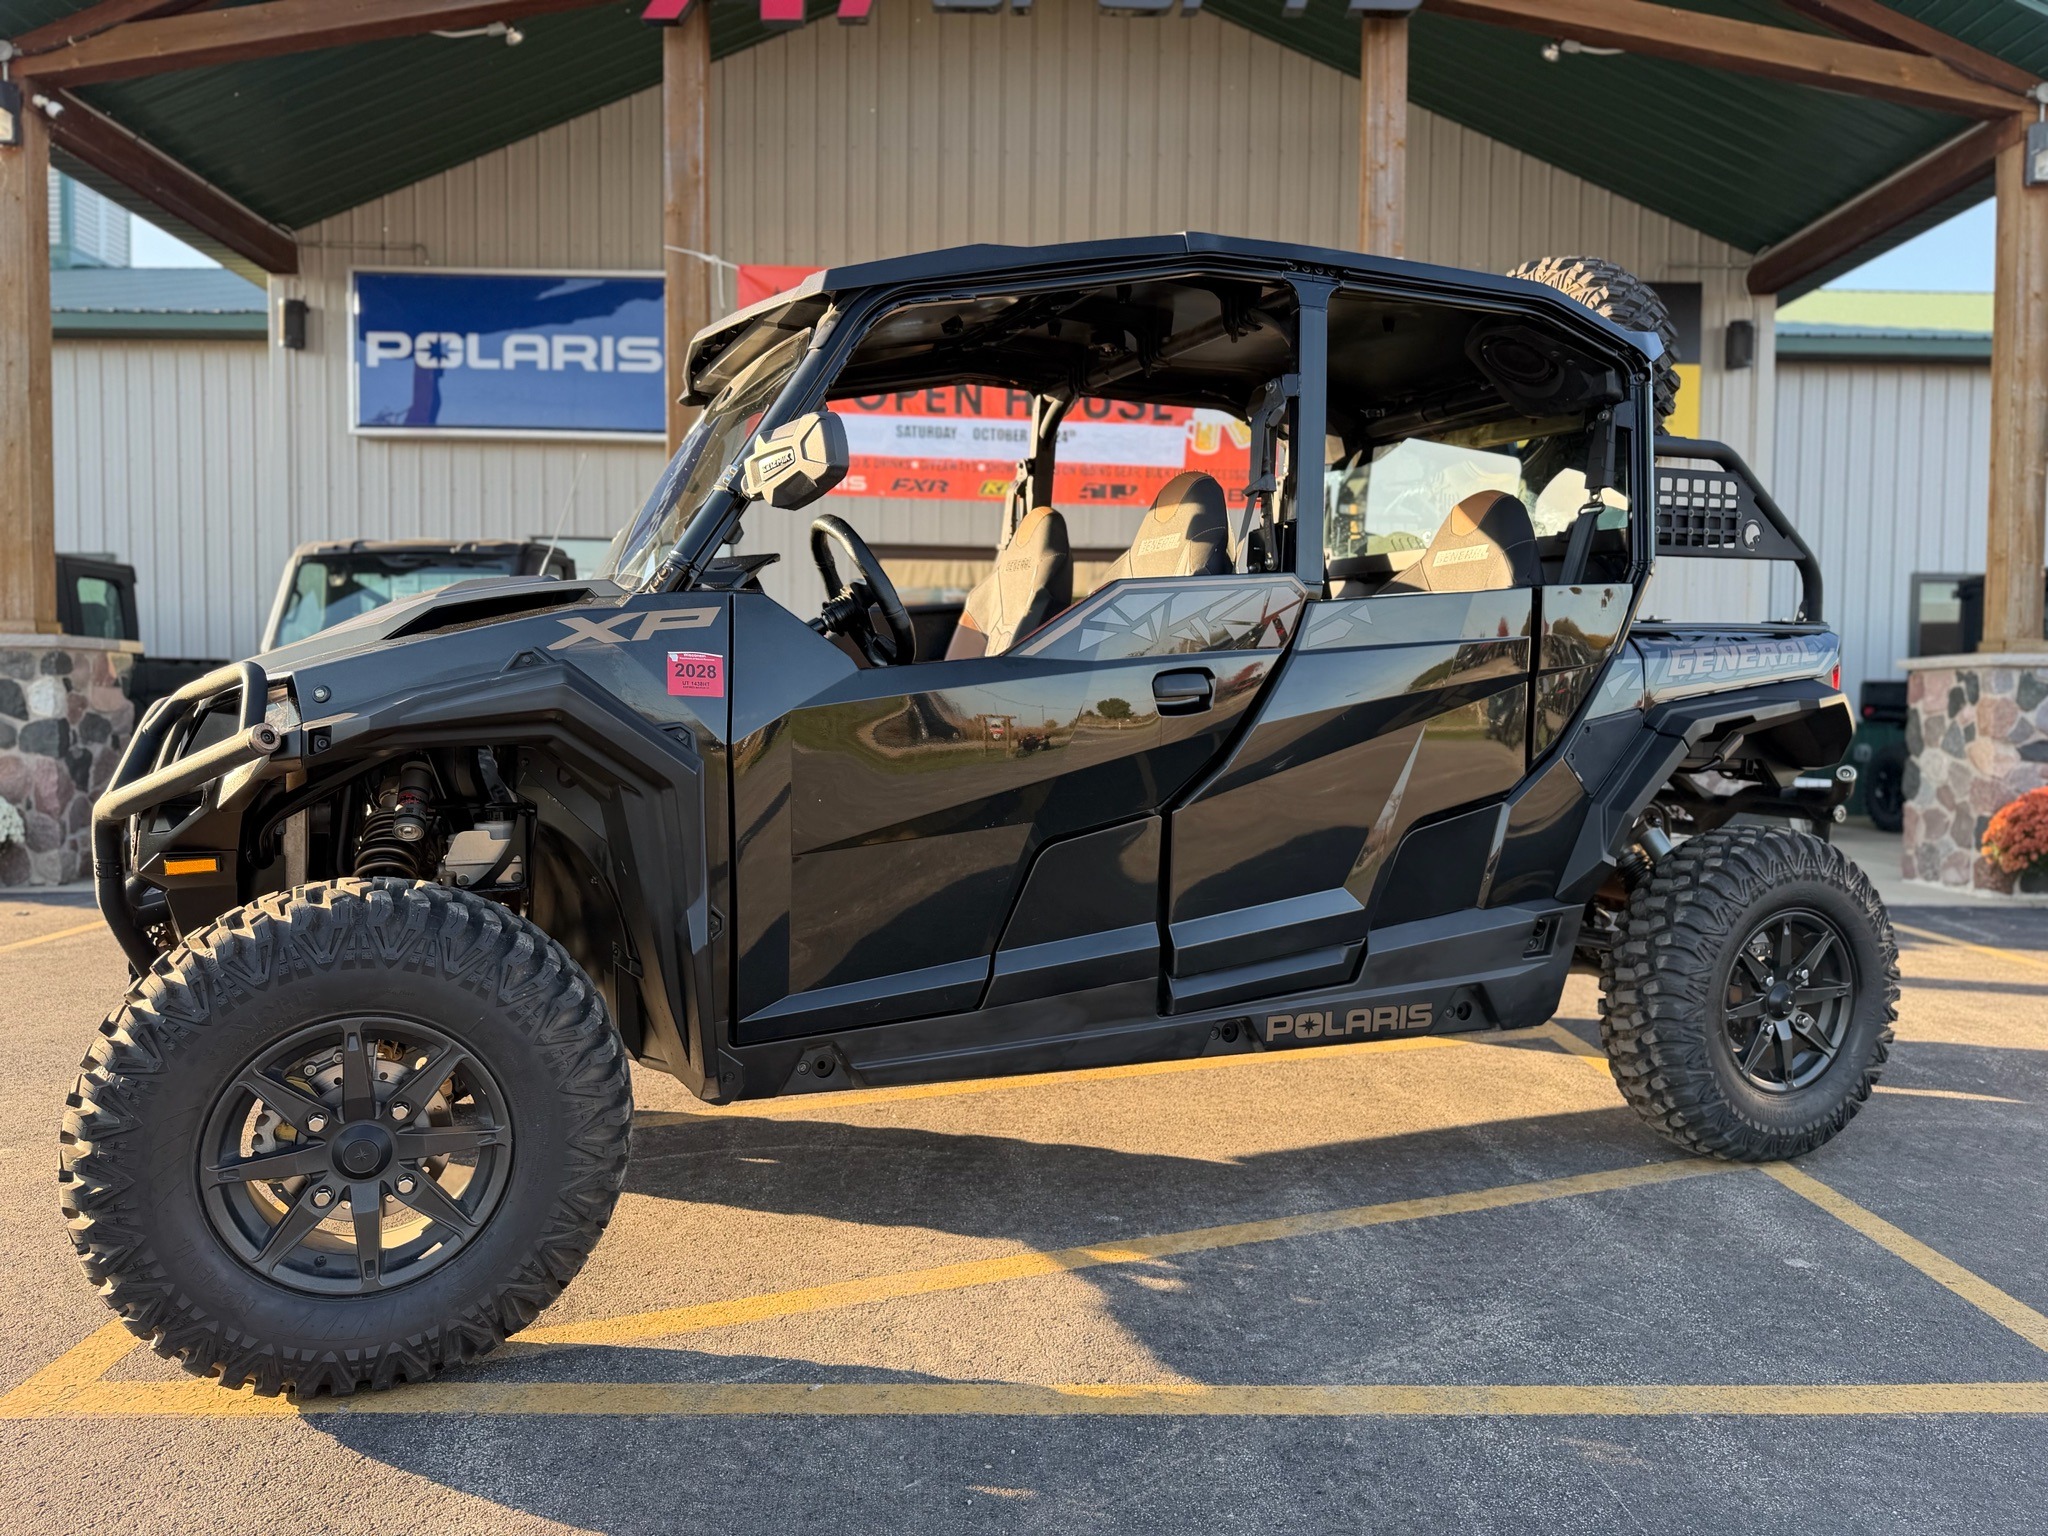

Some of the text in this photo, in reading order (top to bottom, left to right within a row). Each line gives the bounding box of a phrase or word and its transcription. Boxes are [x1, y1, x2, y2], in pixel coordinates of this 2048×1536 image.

[365, 331, 663, 373] POLARIS
[1006, 388, 1173, 421] HUS
[895, 425, 958, 439] SATURDAY
[972, 427, 1028, 442] OCTOBER
[891, 478, 949, 493] FXR
[547, 606, 721, 650] XP
[675, 663, 717, 679] 2028
[1668, 638, 1818, 677] GENERAL
[1265, 1002, 1432, 1042] POLARIS
